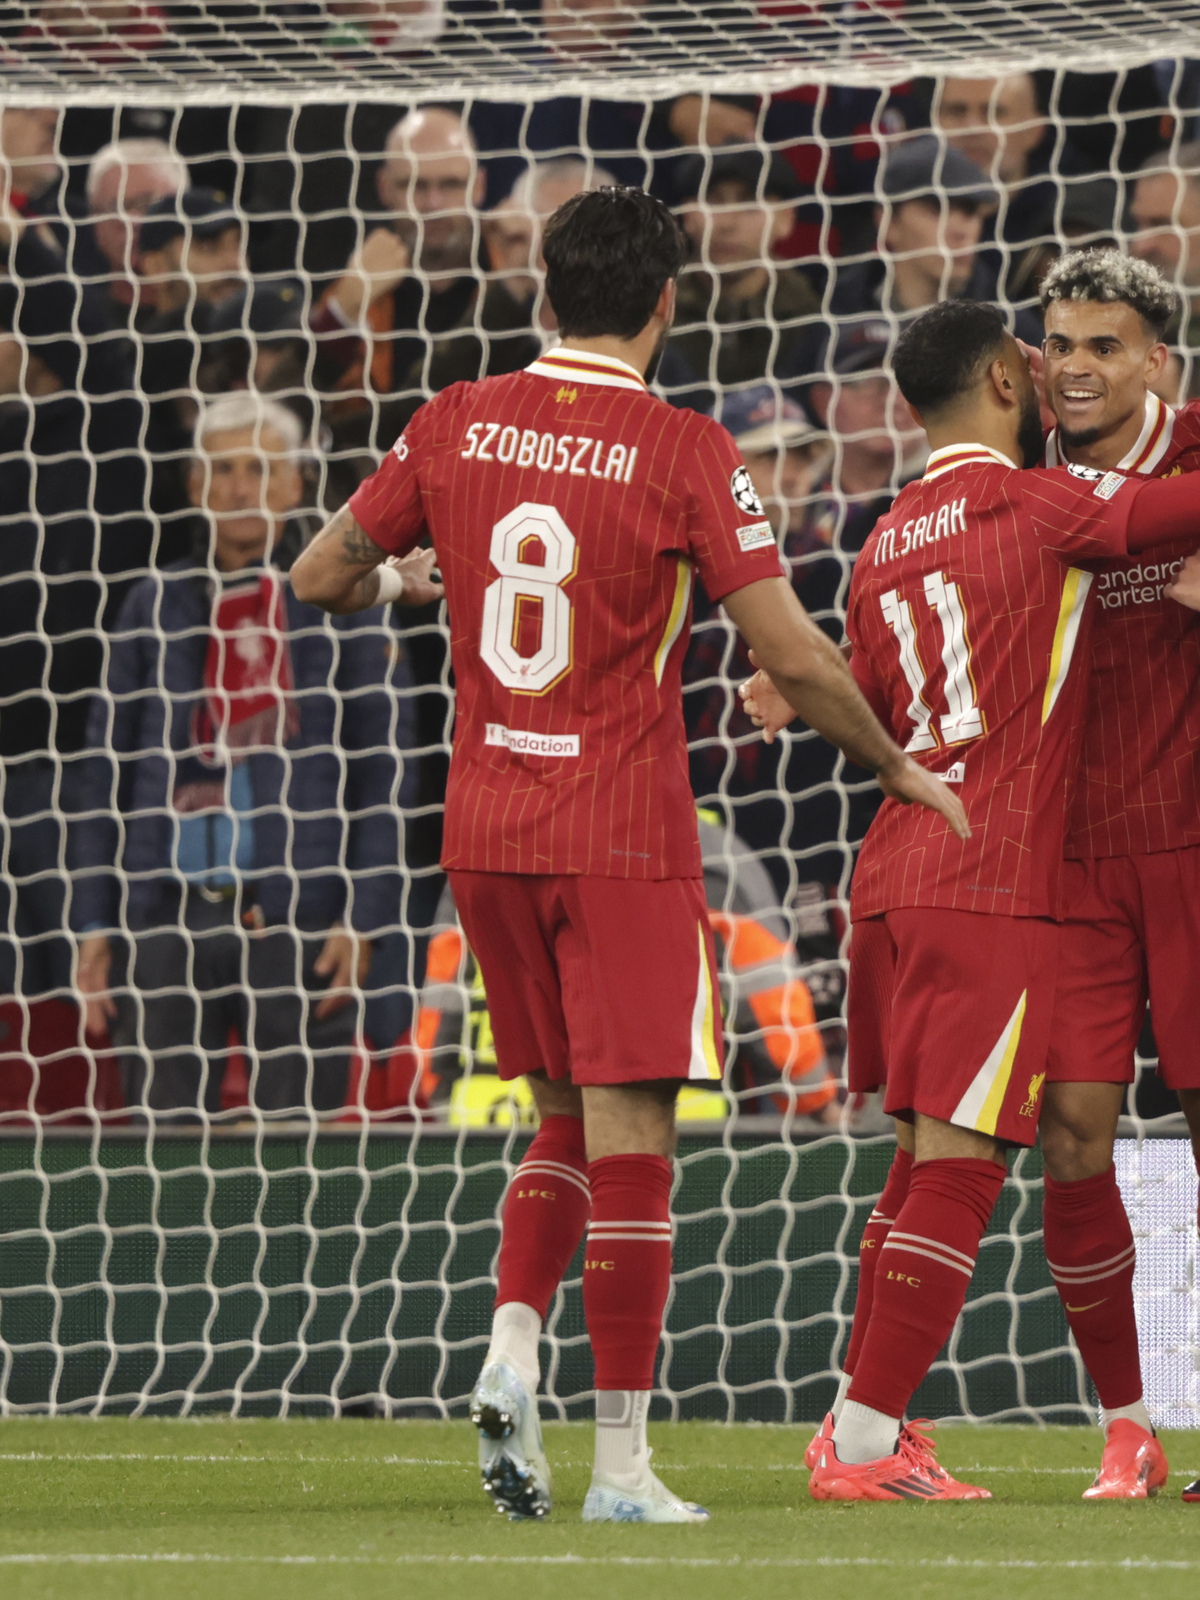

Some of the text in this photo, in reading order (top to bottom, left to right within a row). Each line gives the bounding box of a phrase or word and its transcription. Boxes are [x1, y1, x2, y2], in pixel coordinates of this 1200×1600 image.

[461, 422, 638, 484] SZOBOSZLAI
[874, 497, 967, 567] M.SALAH
[1097, 556, 1184, 590] andard
[480, 501, 580, 696] 8
[1096, 582, 1173, 609] arter
[879, 570, 988, 757] 11
[1019, 1105, 1035, 1117] LFC
[517, 1189, 556, 1200] LFC
[886, 1270, 921, 1288] LFC
